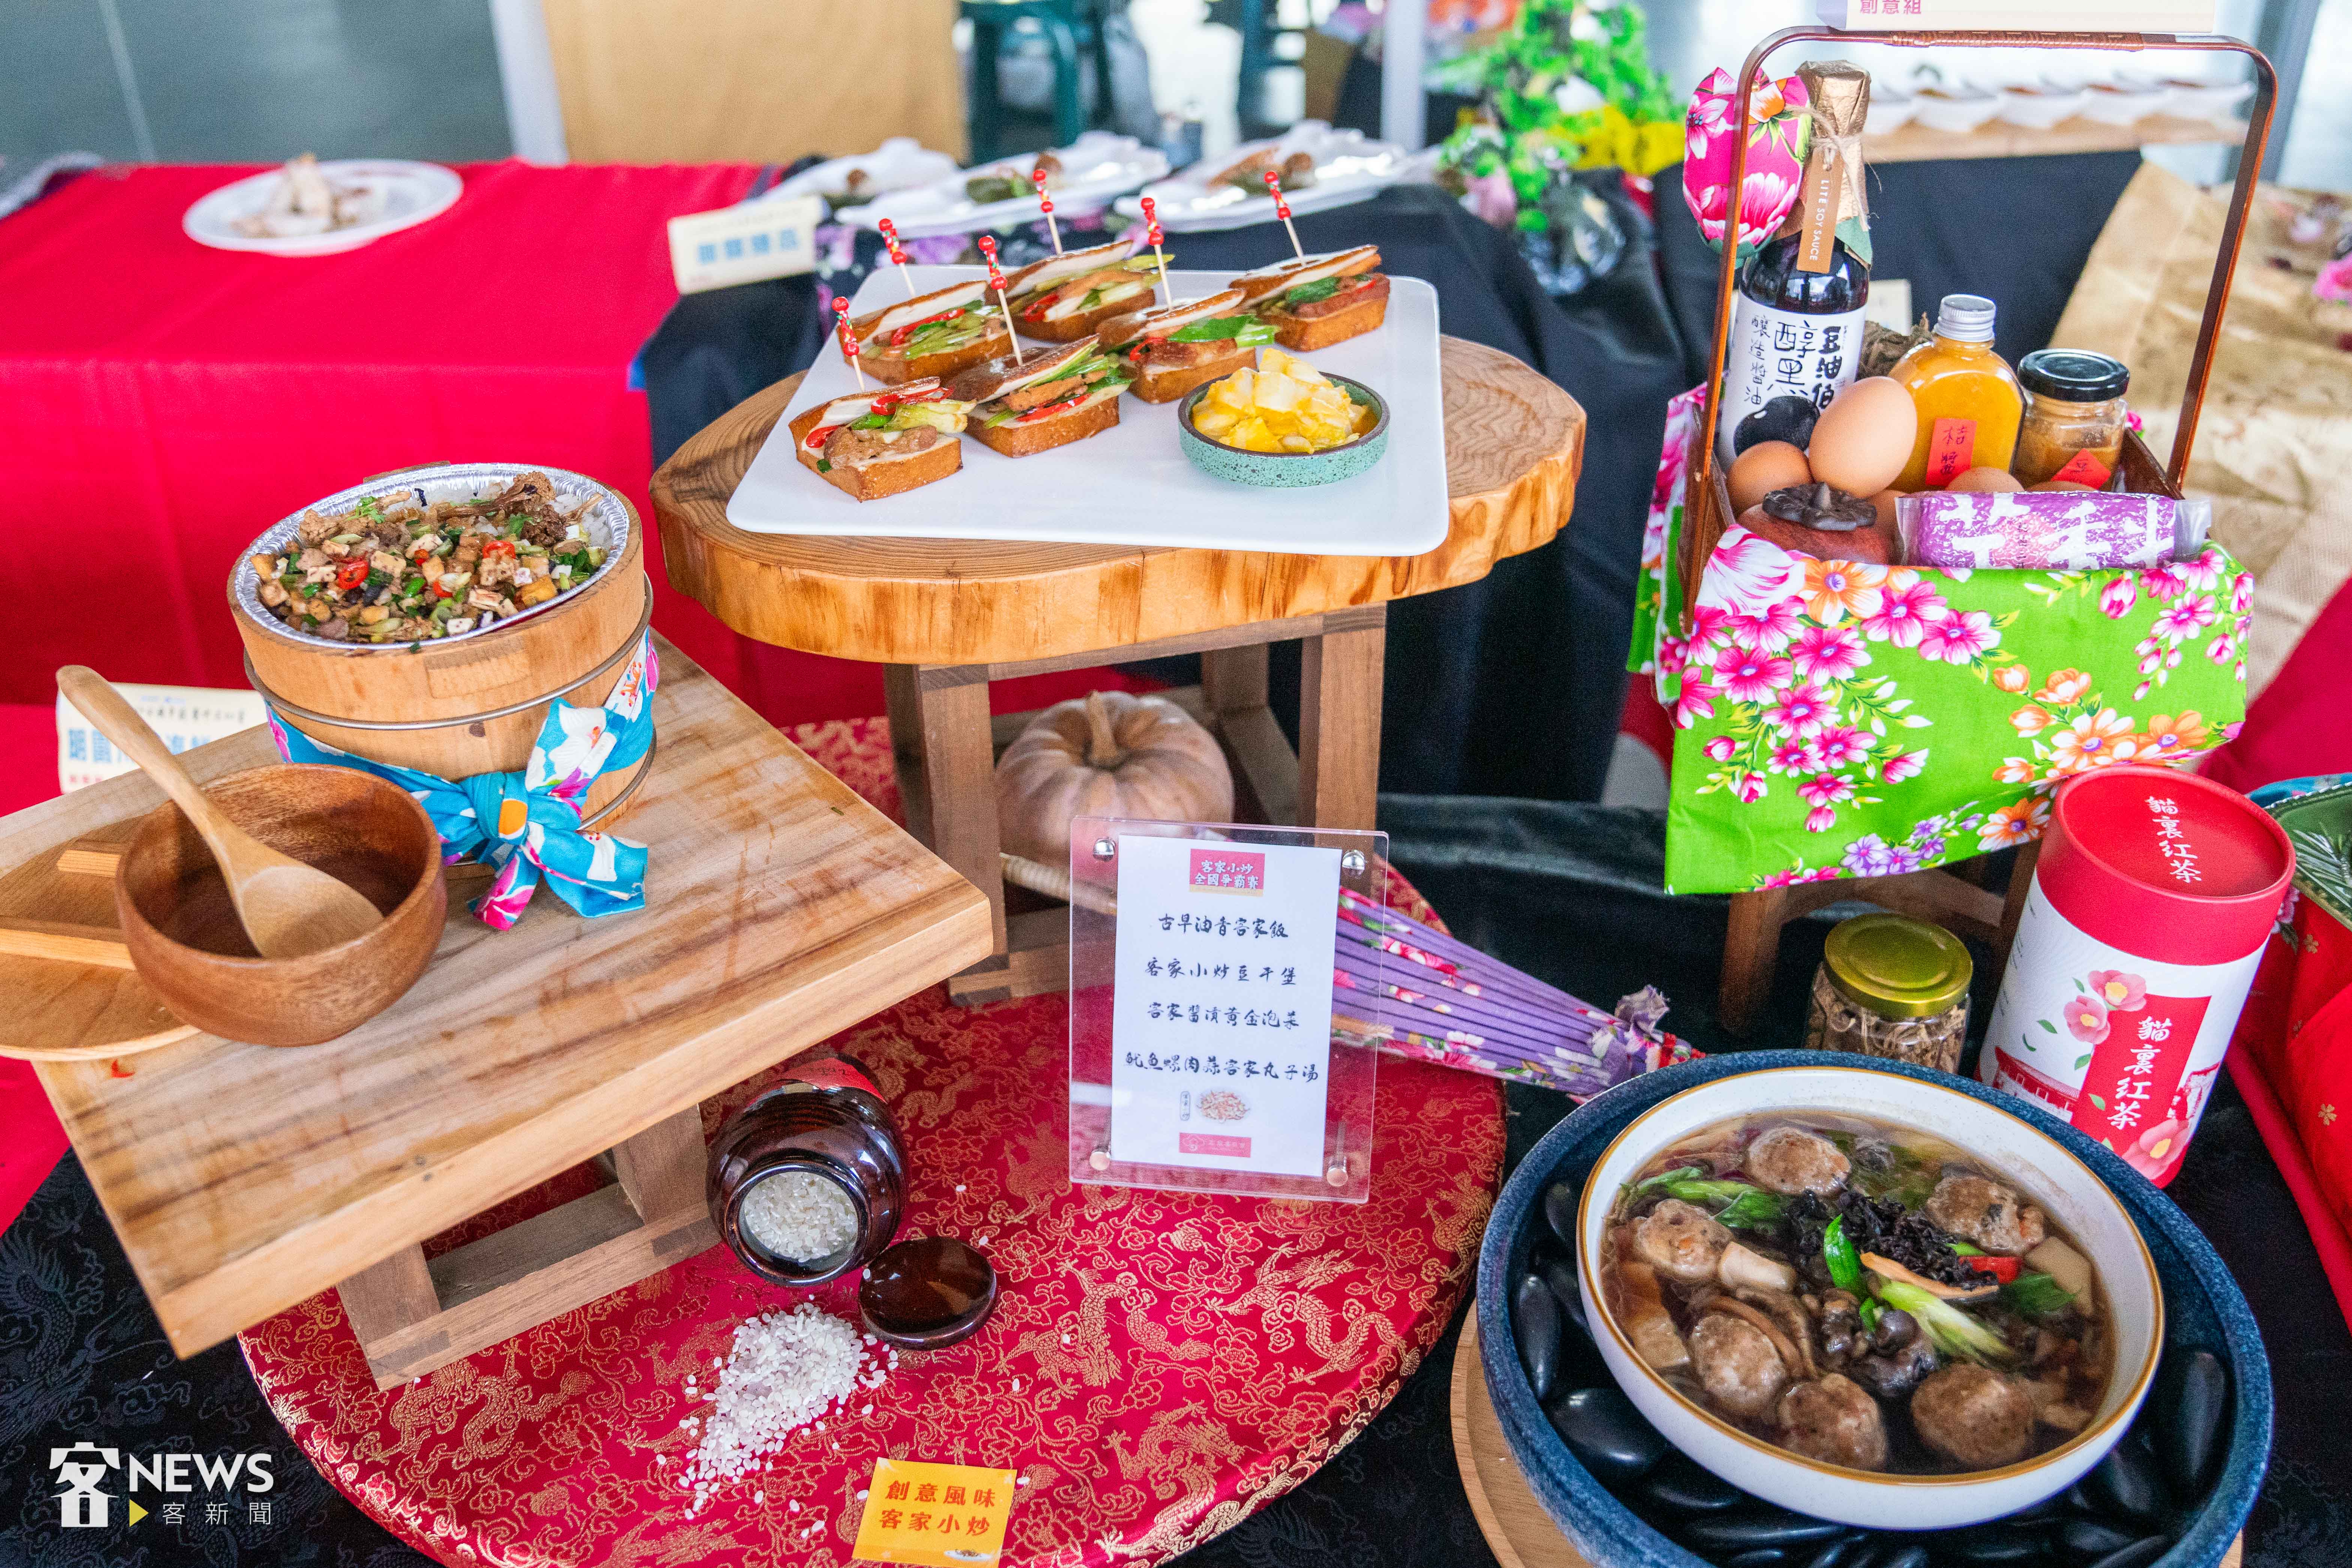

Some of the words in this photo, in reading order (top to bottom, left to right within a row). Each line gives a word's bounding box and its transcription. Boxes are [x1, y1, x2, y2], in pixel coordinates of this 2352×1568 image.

[1860, 0, 1921, 14] 創意組
[1818, 179, 1829, 204] LITE
[1816, 208, 1825, 228] SOY
[1809, 229, 1822, 261] SAUCE
[1767, 320, 1818, 396] 醇黑
[1811, 325, 1842, 409] 豆油伯
[1195, 872, 1259, 889] 全國爭霸賽
[1201, 860, 1254, 875] 客家小炒
[1158, 913, 1289, 938] 古早油香客家飯
[1145, 957, 1296, 985] 客家小炒豆干堡
[885, 1480, 996, 1508] 創意風味
[879, 1508, 990, 1536] 客家小炒
